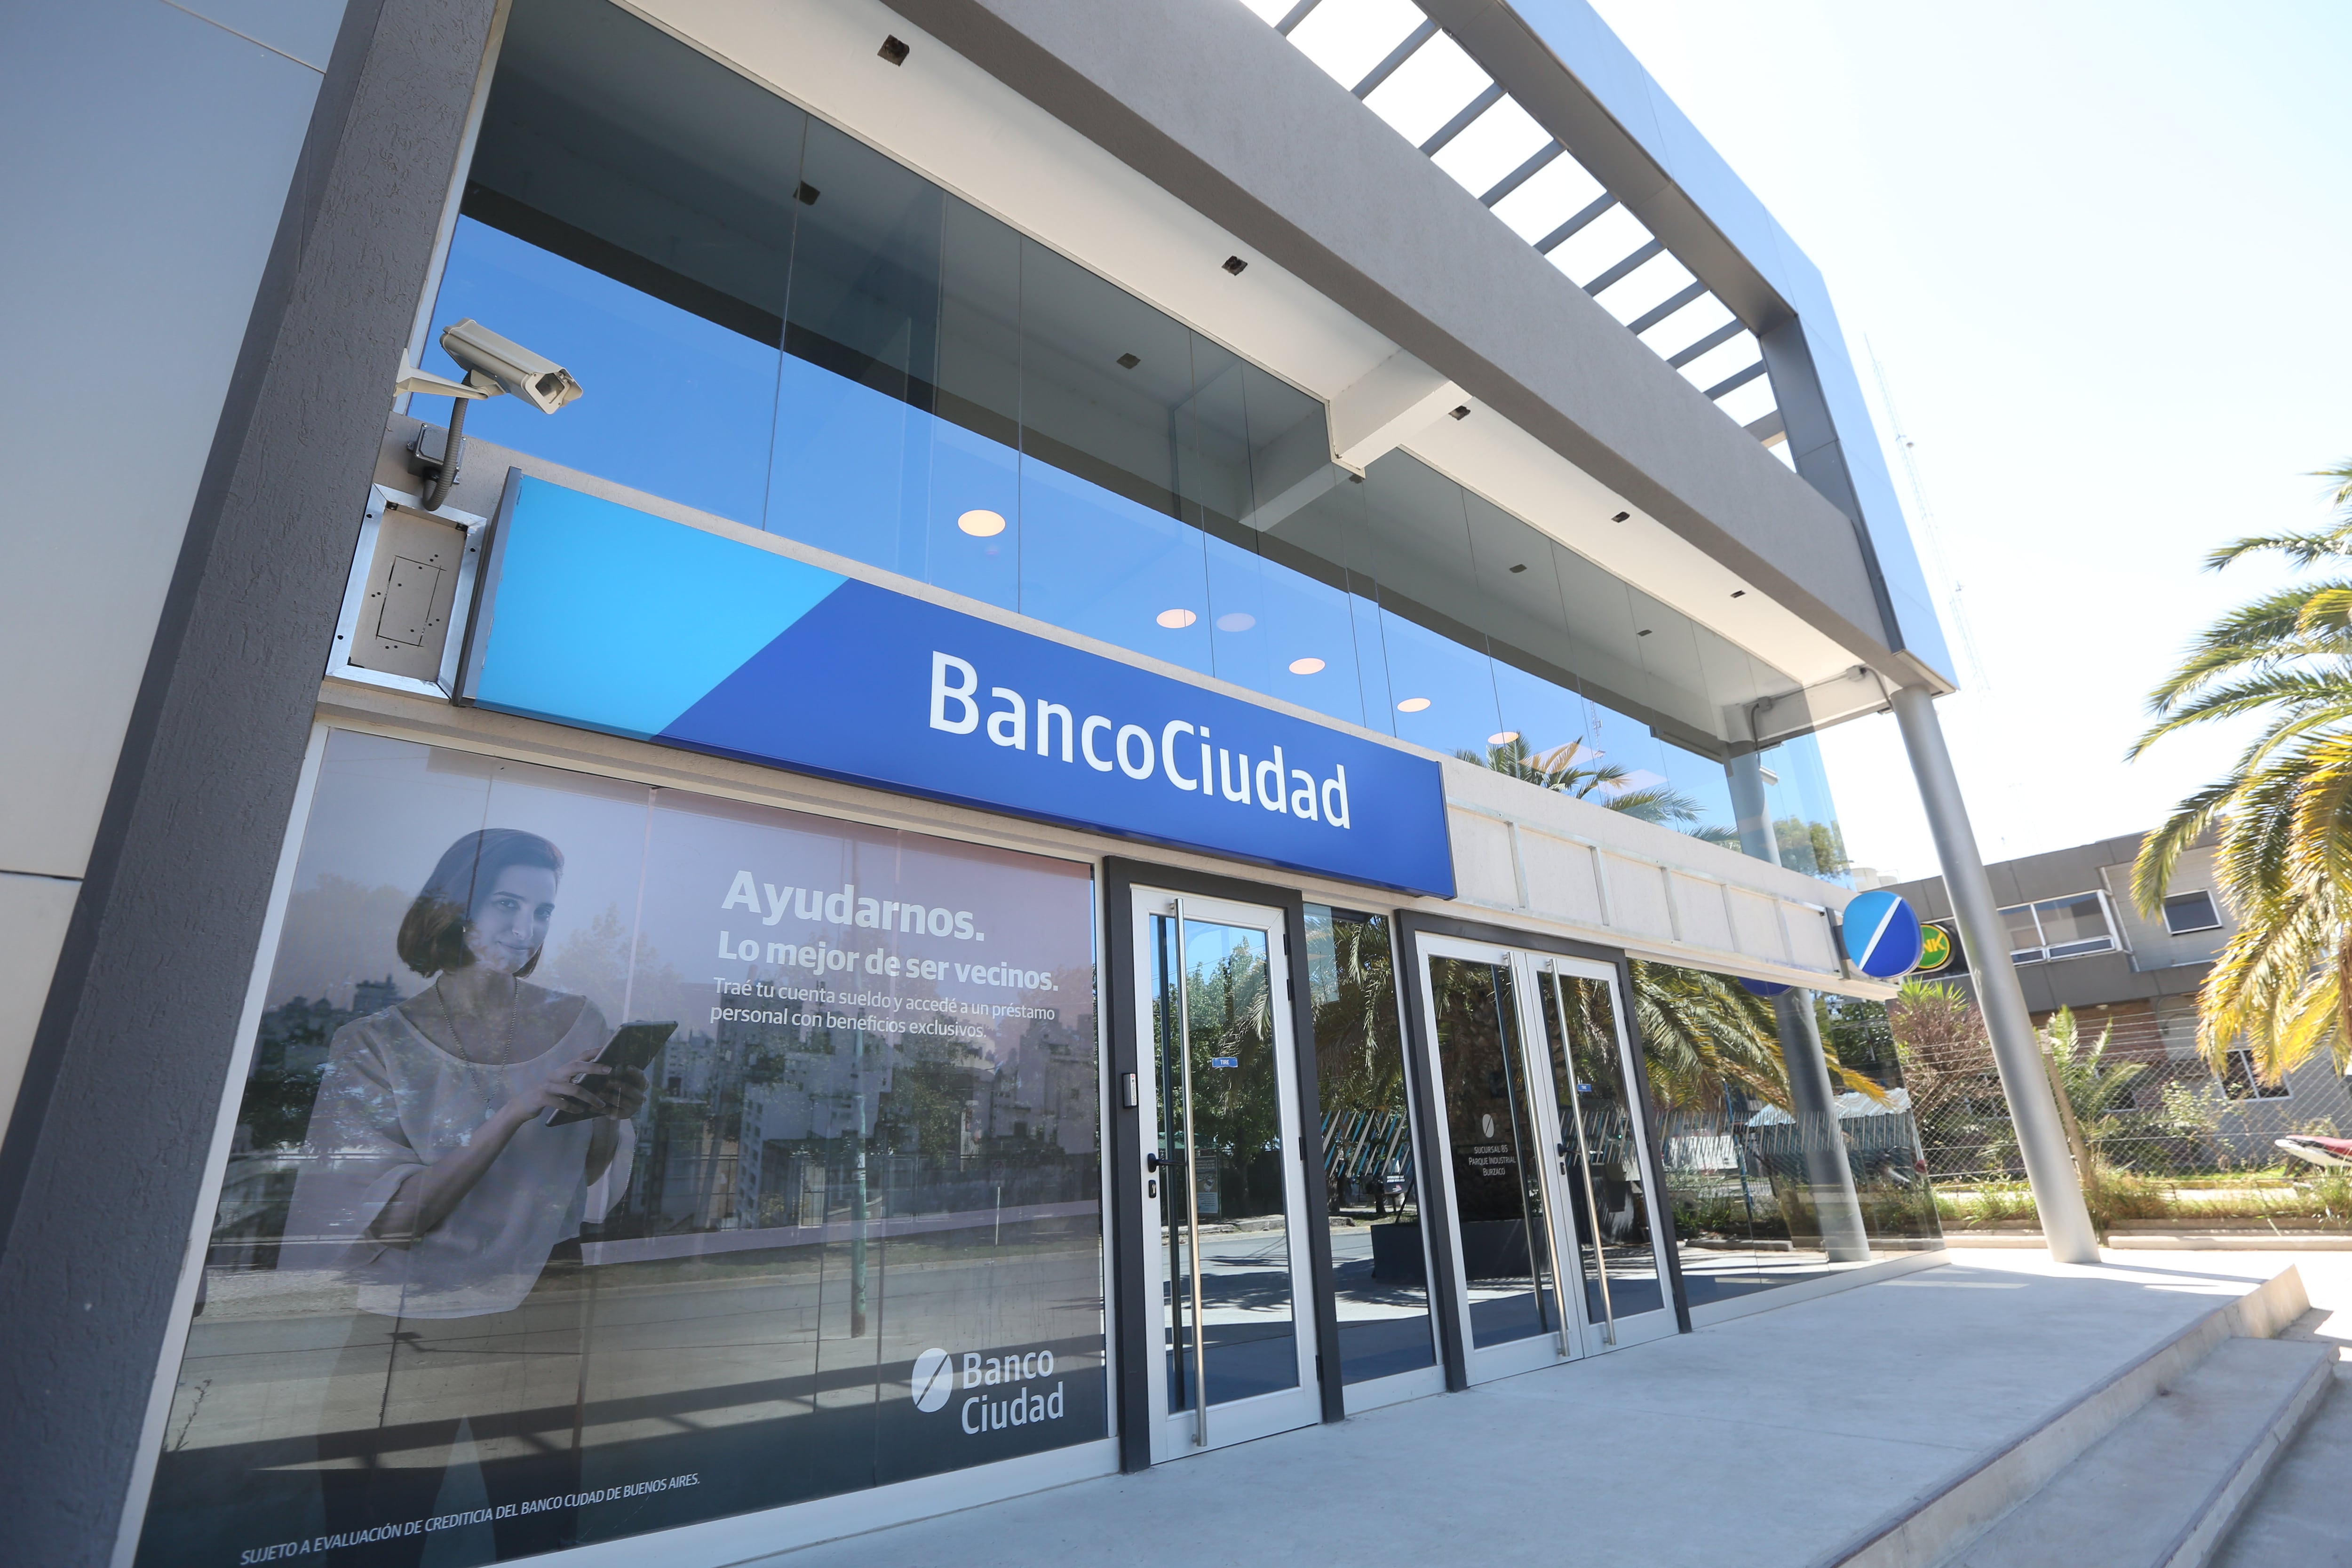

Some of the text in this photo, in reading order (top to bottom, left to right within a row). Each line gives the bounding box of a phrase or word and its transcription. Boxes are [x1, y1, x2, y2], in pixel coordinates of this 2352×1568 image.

[929, 651, 1351, 829] BancoCiudad
[721, 870, 985, 941] Ayudarnos.
[718, 931, 1058, 991] Lo mejor de ser vecinos.
[710, 1007, 986, 1037] personal con beneficios exclusivos.
[713, 977, 1055, 1020] Traé tu cuenta sueldo y accedé a un préstamo
[963, 1350, 1054, 1389] Banco
[961, 1381, 1064, 1435] Ciudad
[240, 1472, 700, 1565] SUJETO A EVALUACIÓN DE CREDITICIA DEL BANCO CUDAD DE BUENOS AIRES.
